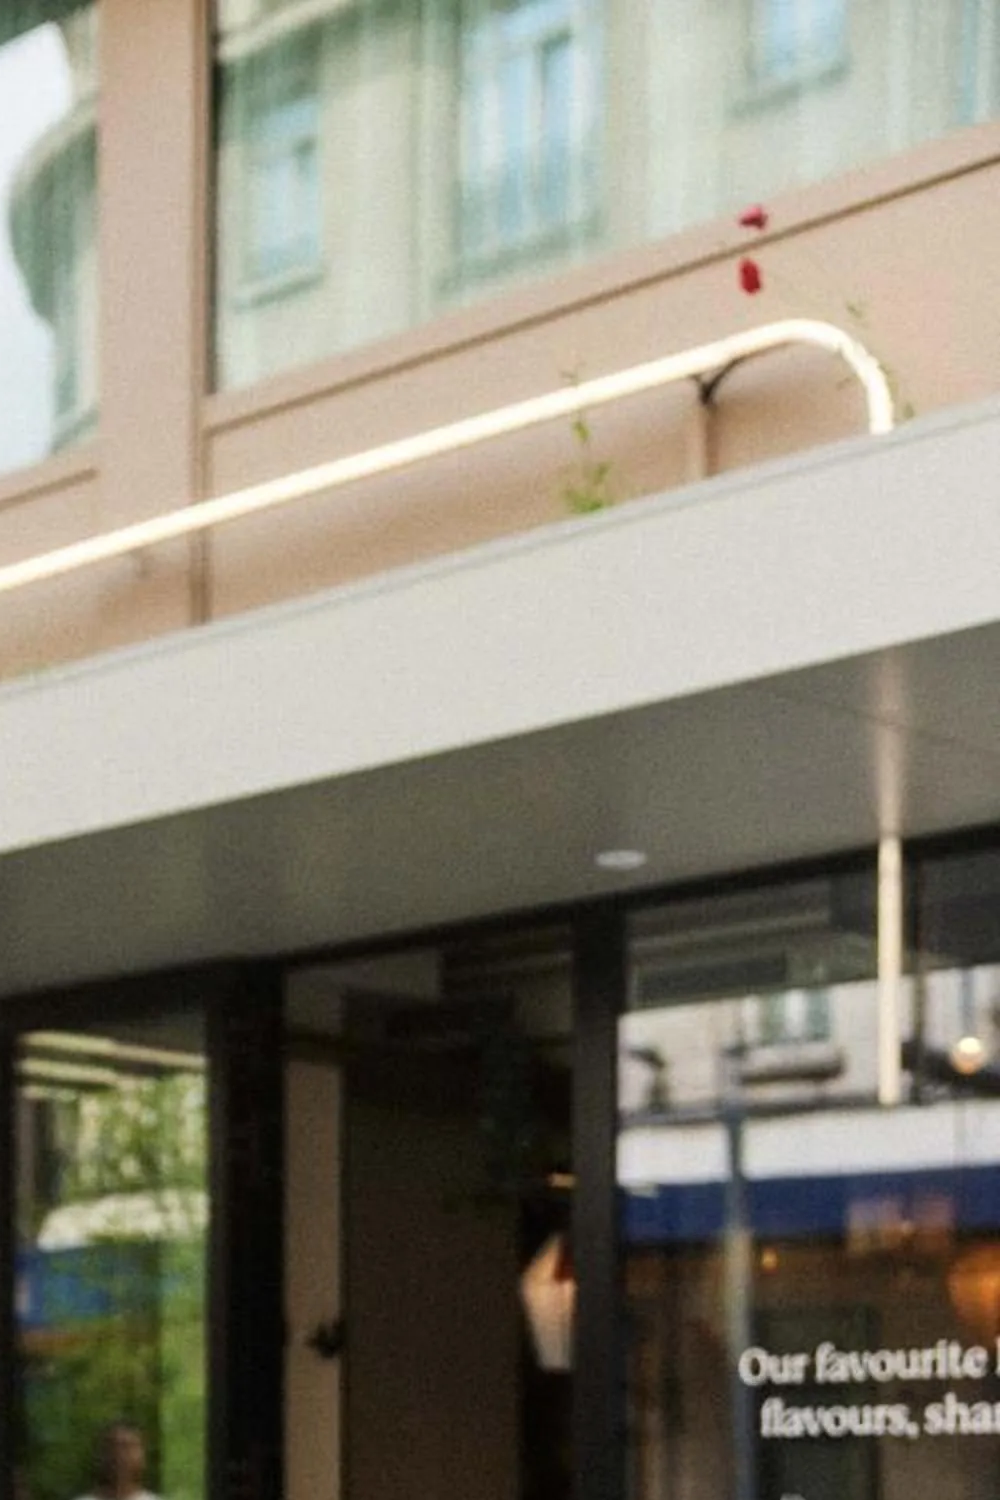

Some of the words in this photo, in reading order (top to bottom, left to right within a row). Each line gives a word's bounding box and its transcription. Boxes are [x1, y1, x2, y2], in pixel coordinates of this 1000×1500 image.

[738, 1346, 810, 1387] Our
[814, 1340, 988, 1384] favourite
[760, 1396, 919, 1440] flavours,
